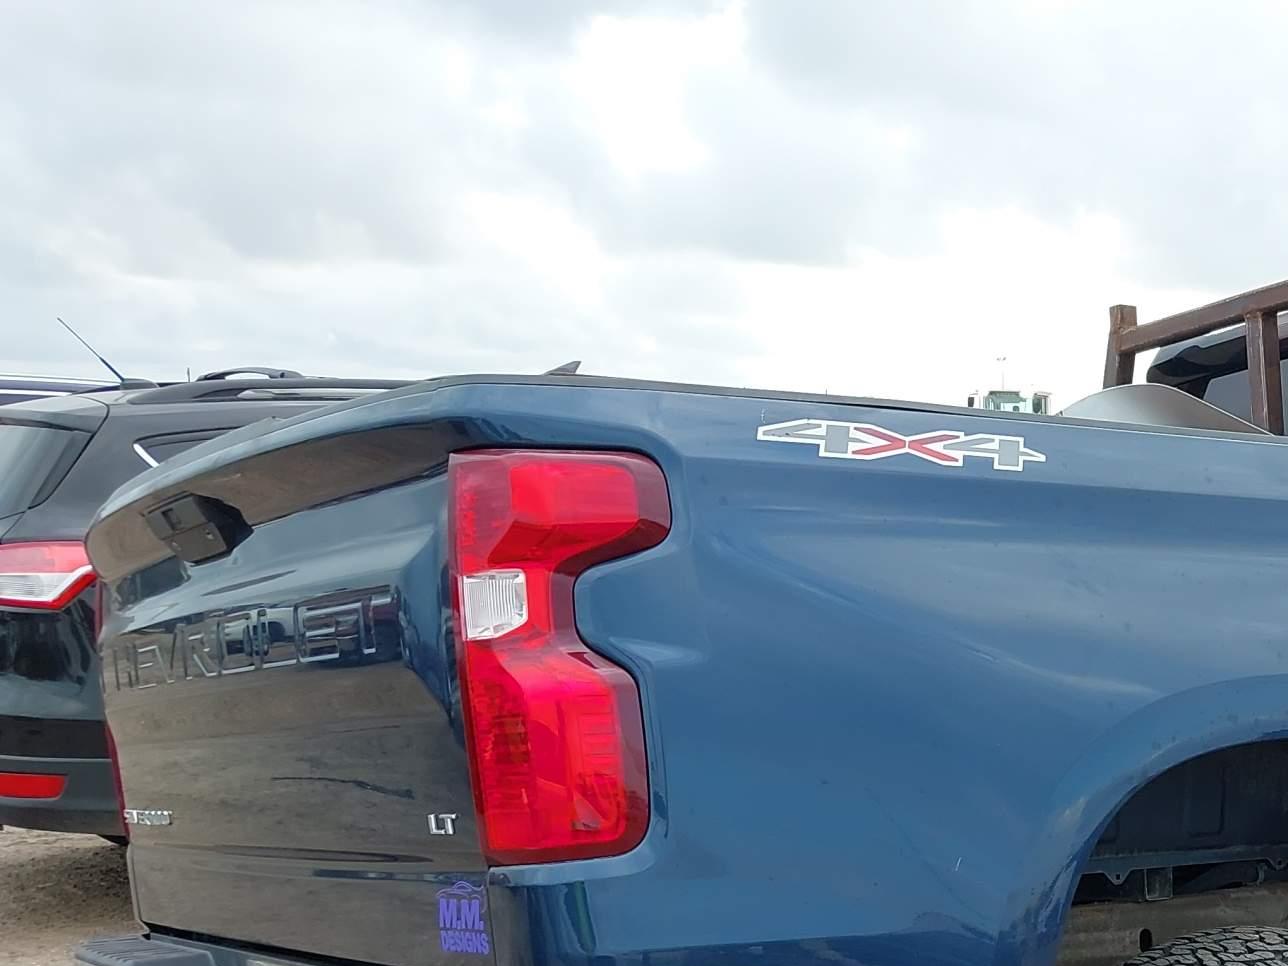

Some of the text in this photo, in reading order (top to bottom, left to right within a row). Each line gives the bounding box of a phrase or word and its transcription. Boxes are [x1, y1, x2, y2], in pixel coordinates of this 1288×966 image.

[427, 813, 457, 835] LT
[439, 898, 484, 931] M.M.
[440, 930, 490, 955] DESIGNS
